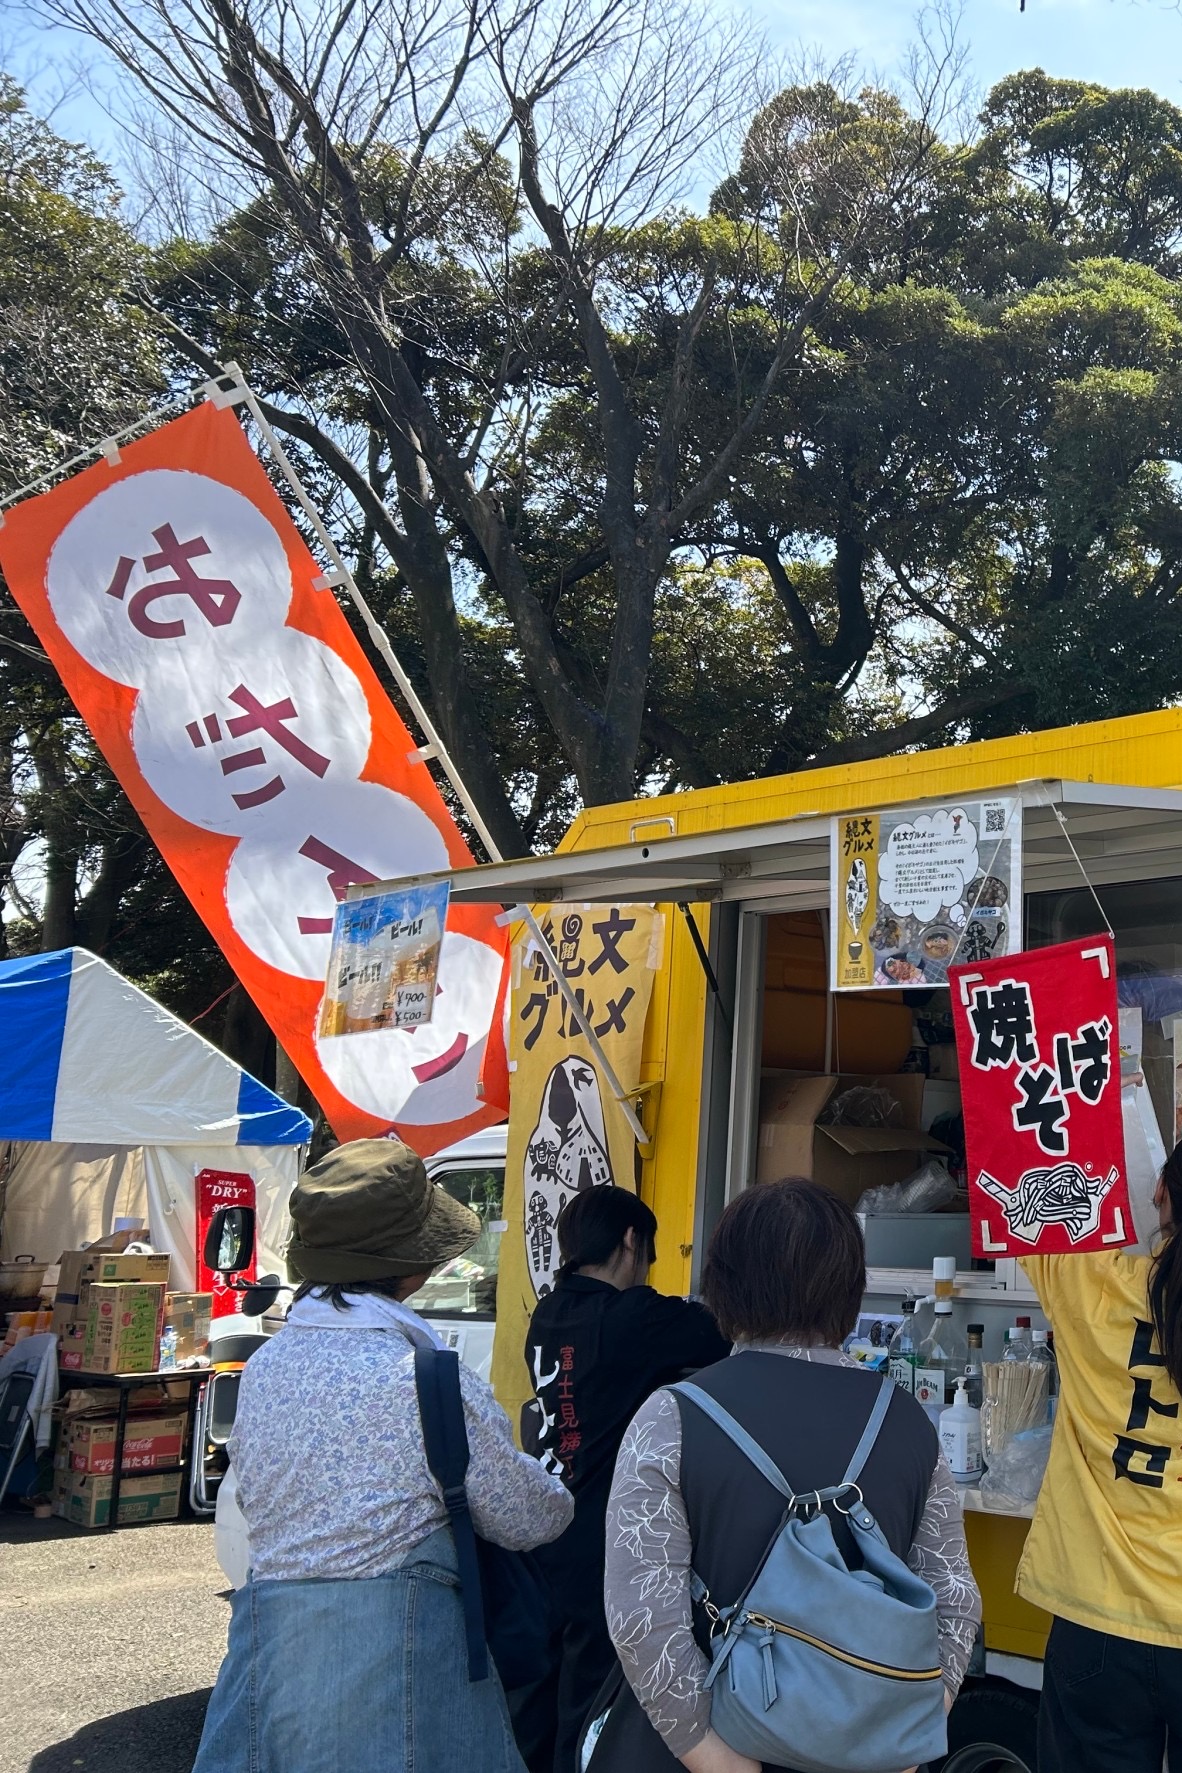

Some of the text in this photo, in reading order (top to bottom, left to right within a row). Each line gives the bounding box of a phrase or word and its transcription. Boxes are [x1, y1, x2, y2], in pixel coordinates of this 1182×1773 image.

[842, 838, 874, 856] グルメ
[845, 818, 872, 837] 縄文
[534, 909, 636, 982] 縄文
[521, 980, 635, 1051] グルメ
[967, 978, 1112, 1155] 焼そば
[923, 1377, 938, 1392] BEAM
